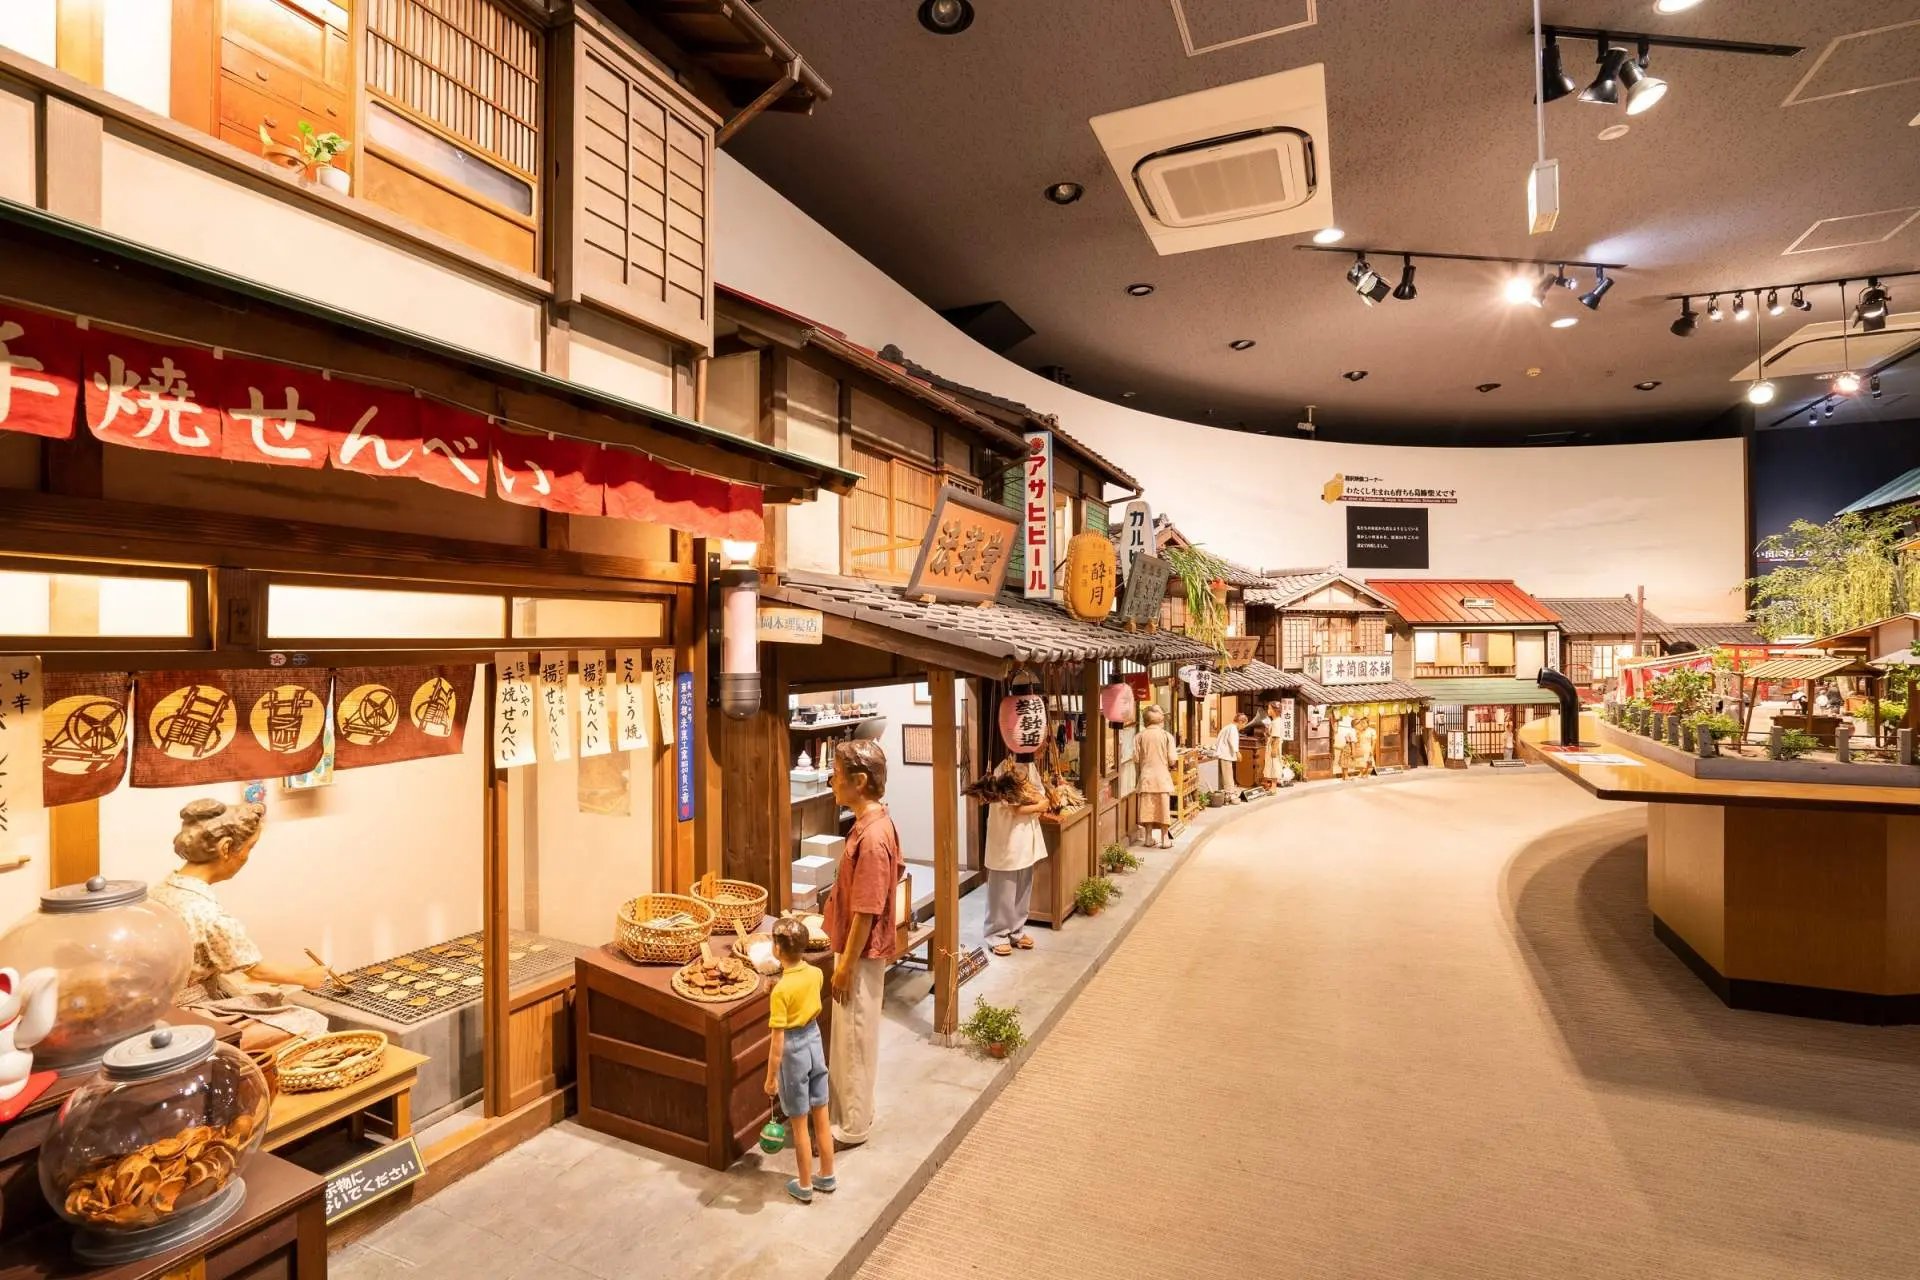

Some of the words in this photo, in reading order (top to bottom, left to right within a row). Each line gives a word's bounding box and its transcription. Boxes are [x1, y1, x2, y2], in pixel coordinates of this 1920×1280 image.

[1028, 455, 1047, 591] アサヒビール
[501, 666, 519, 761] 手焼せんべい
[516, 661, 530, 718] ほていやの
[543, 663, 560, 754] 揚せんべい
[583, 663, 598, 749] 揚せんべい
[623, 657, 642, 740] さんしょう焼
